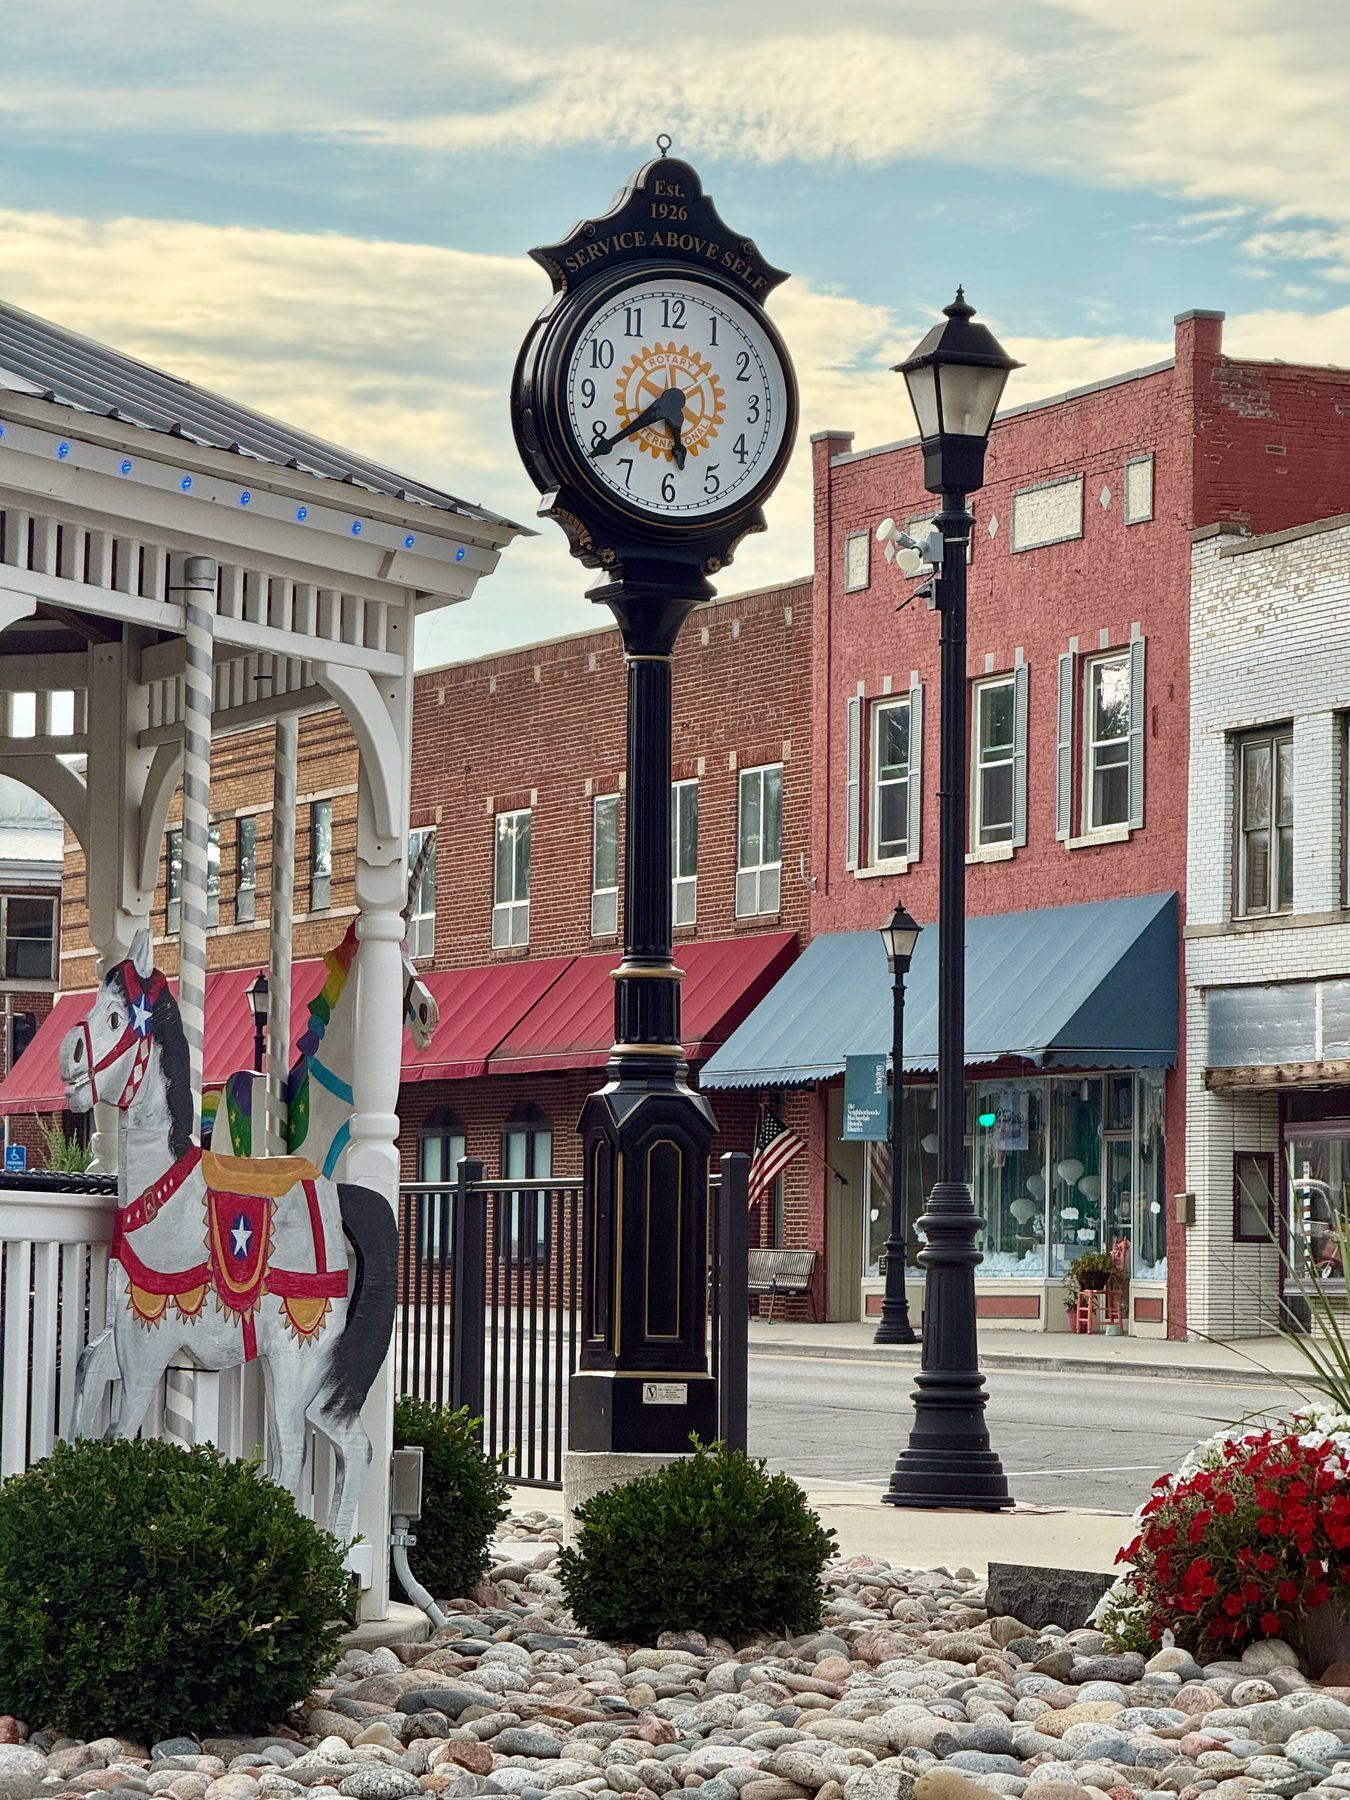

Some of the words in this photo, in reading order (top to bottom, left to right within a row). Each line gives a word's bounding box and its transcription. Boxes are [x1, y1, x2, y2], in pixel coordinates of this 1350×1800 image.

[654, 180, 685, 198] Est.
[650, 202, 688, 221] 1926
[565, 231, 647, 273] SERVICE
[651, 233, 719, 260] ABOVE
[720, 250, 768, 291] SELF
[623, 307, 643, 337] 11
[661, 299, 687, 330] 12
[708, 316, 719, 346] 1
[589, 338, 614, 369] 10
[648, 354, 695, 370] ROTARY
[735, 351, 752, 382] 2
[581, 378, 596, 409] 9
[746, 394, 760, 424] 3
[591, 420, 607, 453] 8
[640, 423, 709, 449] TERNAONAL
[732, 433, 749, 464] 4
[616, 458, 633, 490] 7
[661, 473, 675, 502] 6
[704, 463, 720, 494] 5
